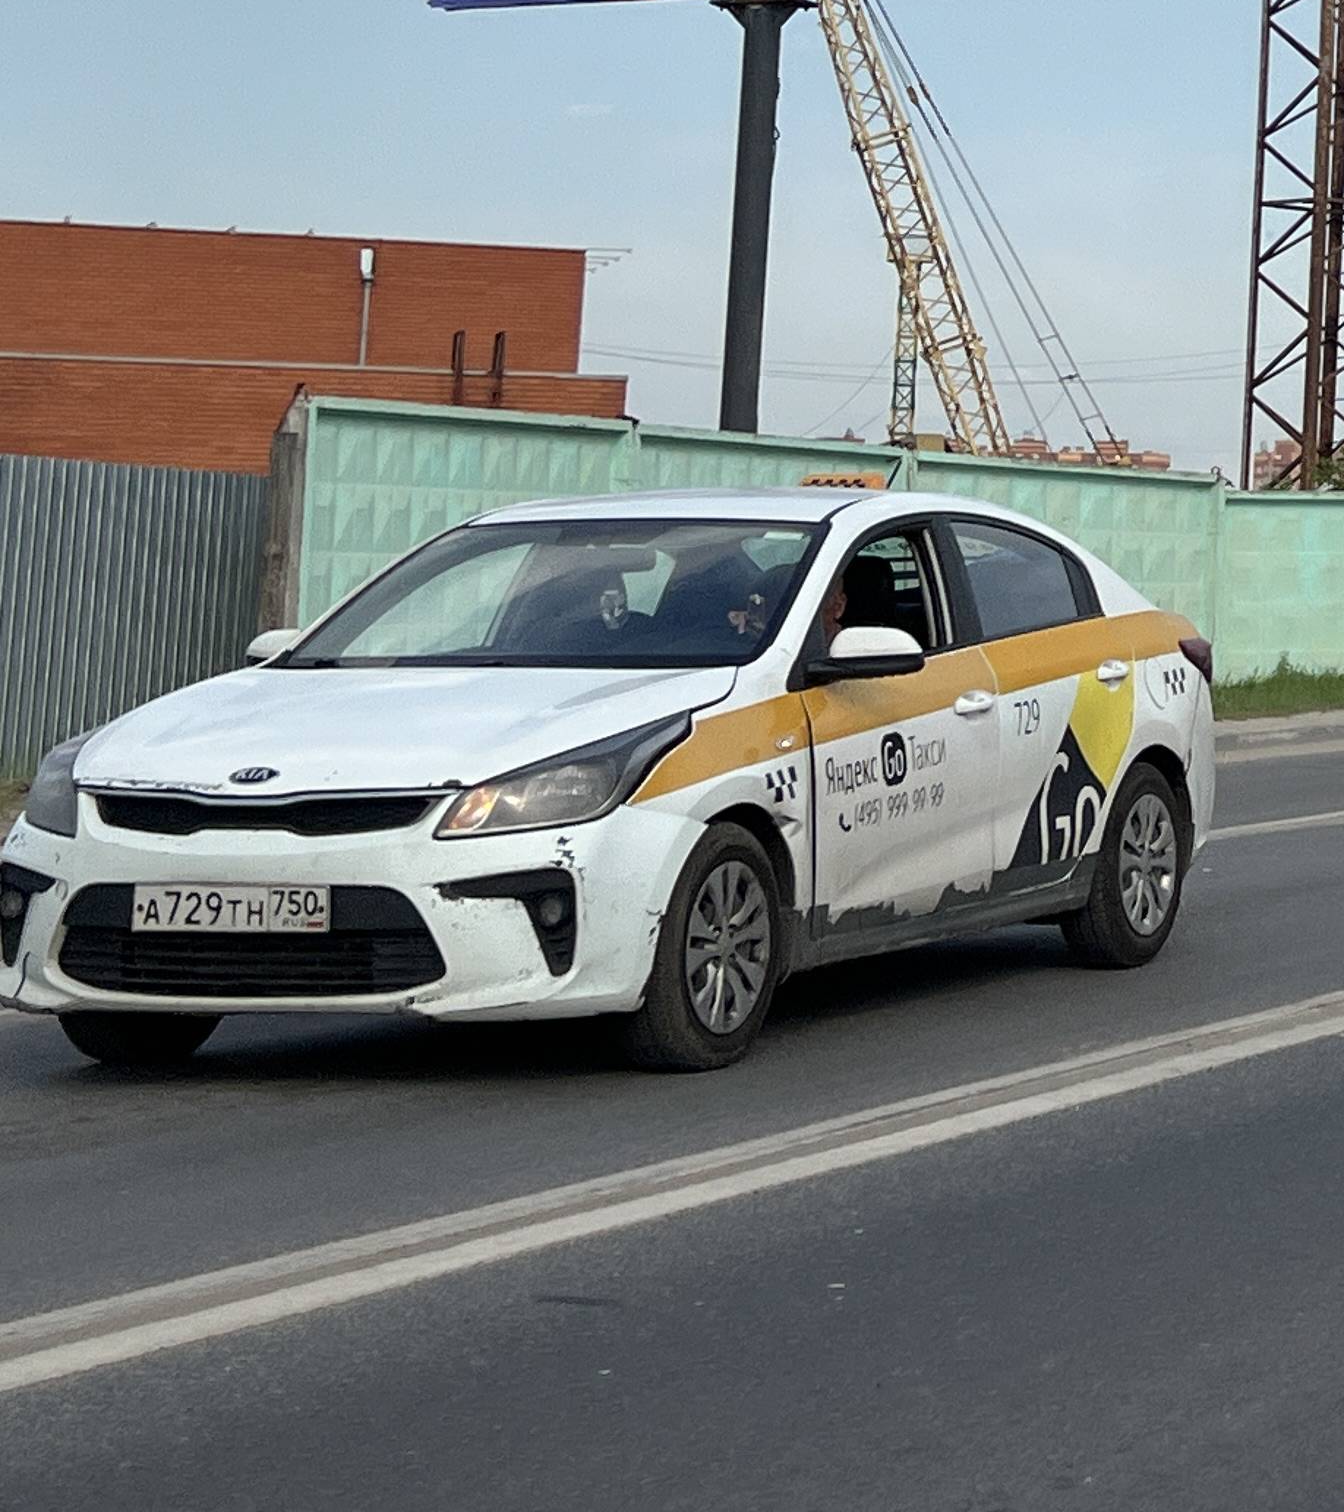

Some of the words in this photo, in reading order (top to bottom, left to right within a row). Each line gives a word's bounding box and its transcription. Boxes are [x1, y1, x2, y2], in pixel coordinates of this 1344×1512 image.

[1014, 698, 1041, 736] 729
[825, 755, 878, 796] Яндекс
[883, 742, 904, 780] Go
[907, 735, 946, 771] Такси
[143, 891, 264, 926] А729ТН
[271, 890, 318, 916] 750
